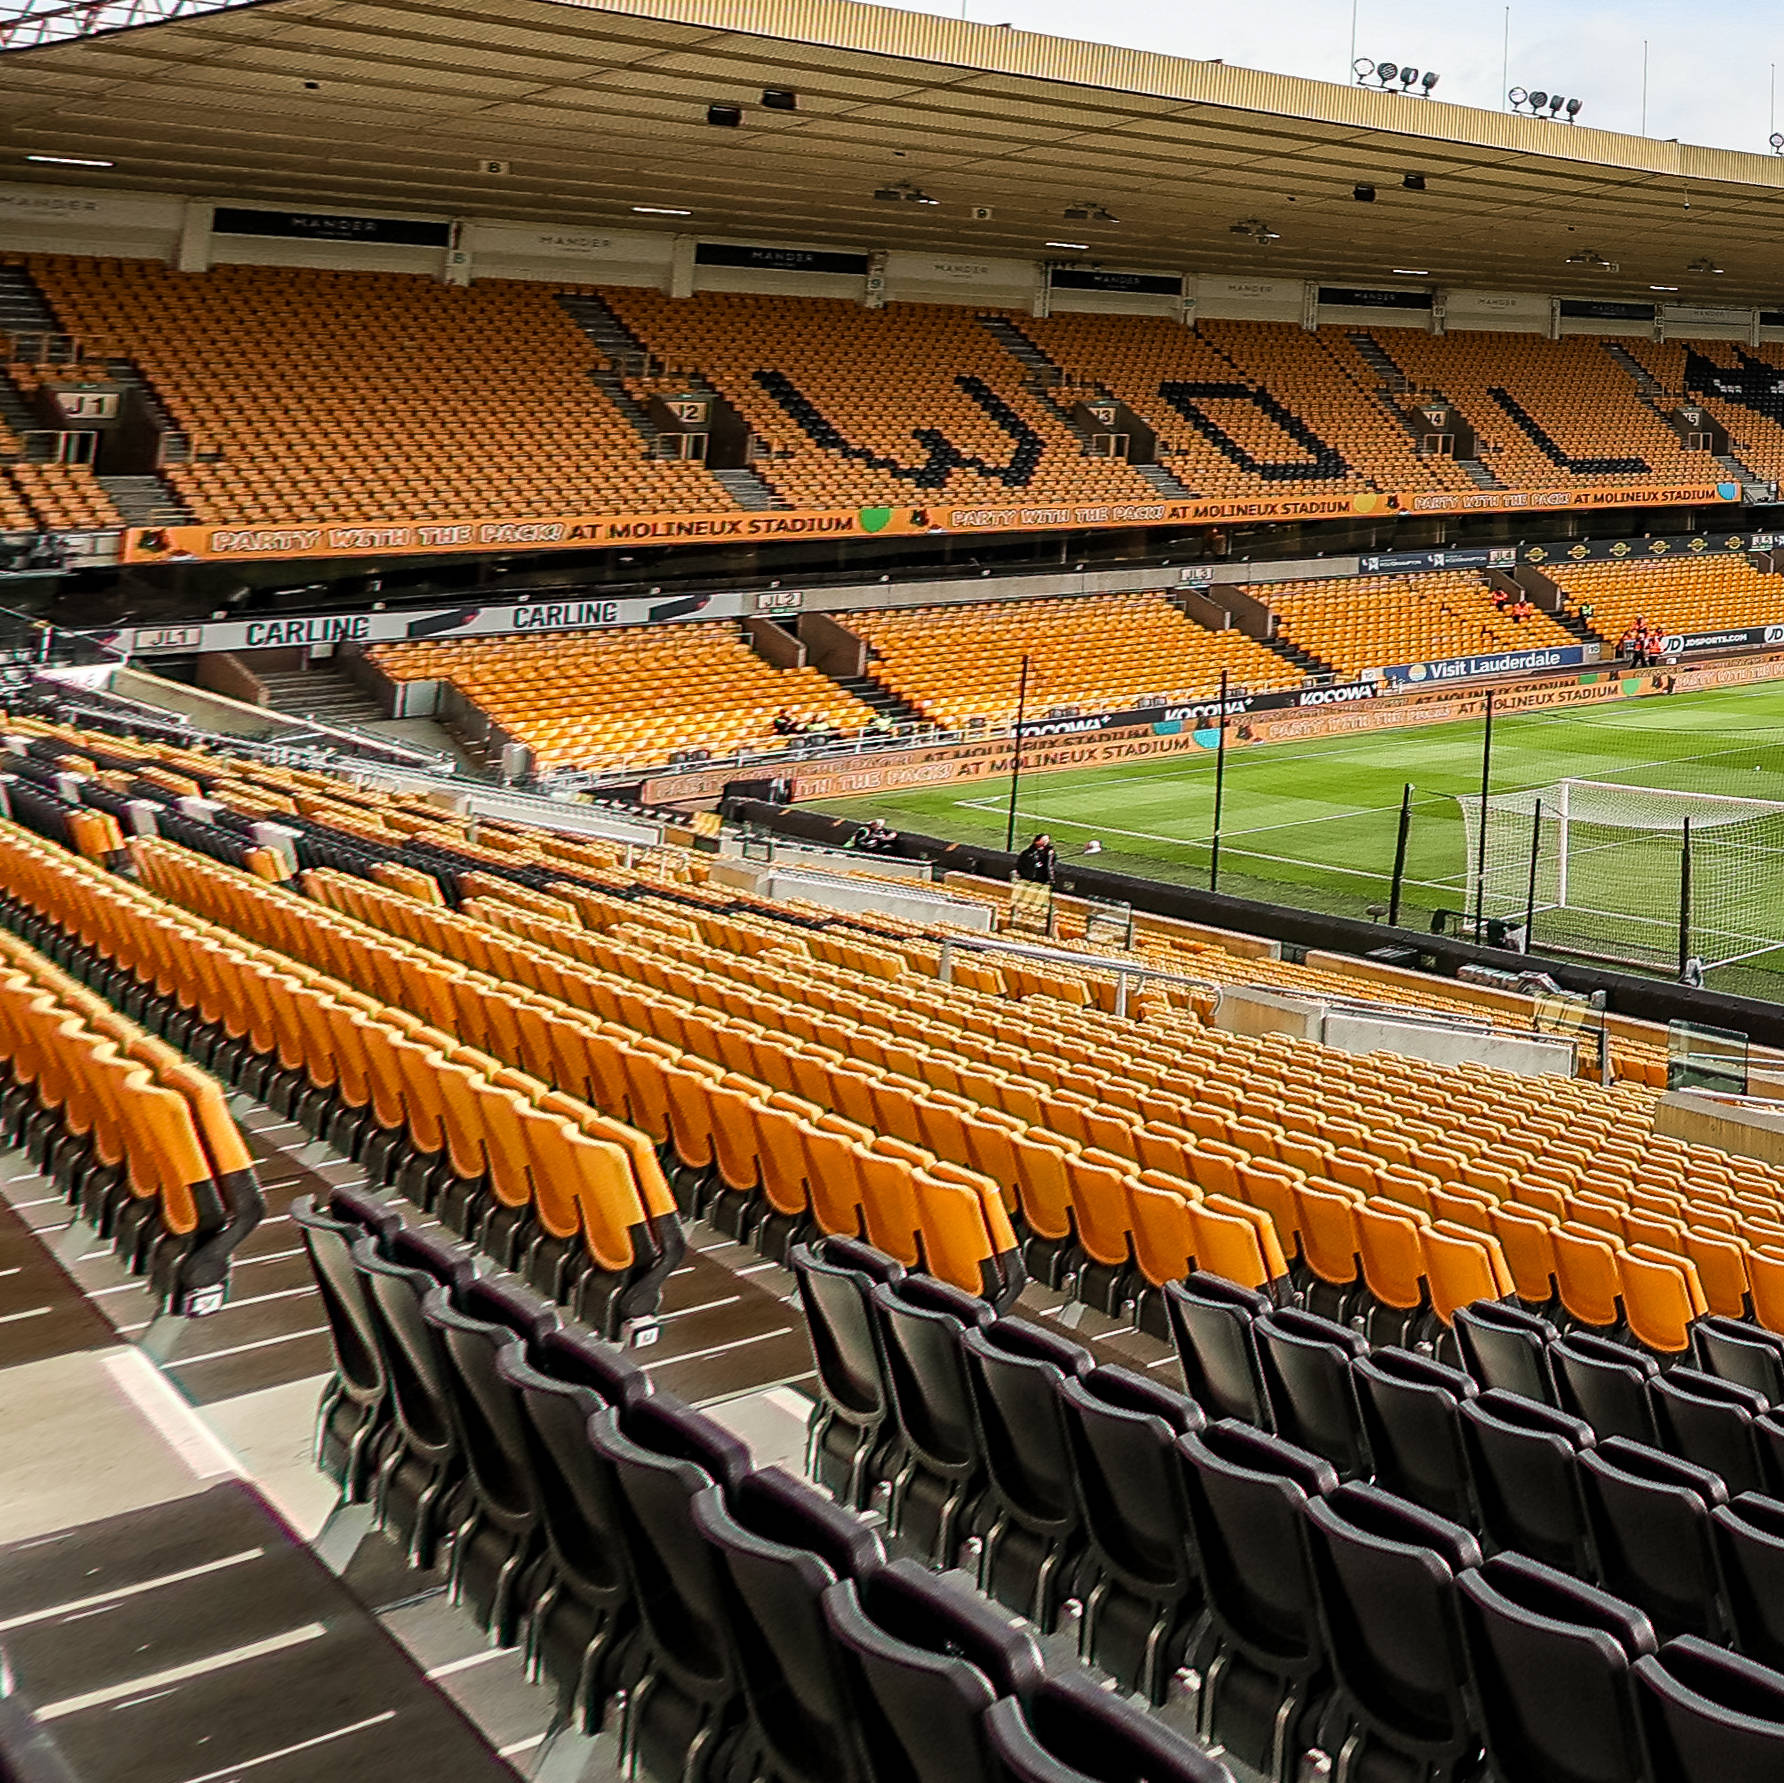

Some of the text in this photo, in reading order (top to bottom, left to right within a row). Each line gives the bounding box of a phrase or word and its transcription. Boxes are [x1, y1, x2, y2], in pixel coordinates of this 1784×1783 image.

[291, 219, 377, 232] MANDER
[539, 235, 611, 248] MANDER
[752, 251, 814, 264] MANDER
[934, 263, 989, 274] MANDER
[64, 396, 104, 414] J1
[1503, 494, 1528, 507] THE
[1574, 492, 1590, 504] AT
[1593, 491, 1659, 504] MOLINEUX
[1661, 489, 1715, 502] STADIUM
[951, 501, 1349, 527] PARTY WITH THE PACK! AT MOLINEUX STADIUM
[211, 516, 853, 553] PARTY WITH THE PACK! AT MOLINEUX STADIUM
[513, 601, 617, 629] CARLING
[151, 630, 185, 646] JL1
[247, 616, 369, 646] CARLING
[1685, 633, 1748, 648] JDSPORTS.COM
[1766, 627, 1784, 641] JD
[1430, 651, 1561, 679] Visit Lauderdale
[1458, 702, 1475, 714] AT
[1558, 684, 1618, 703] STADIUM
[838, 771, 881, 791] THE
[958, 762, 984, 776] AT
[991, 748, 1098, 772] MOLINEUX
[1103, 737, 1190, 760] STADIUM
